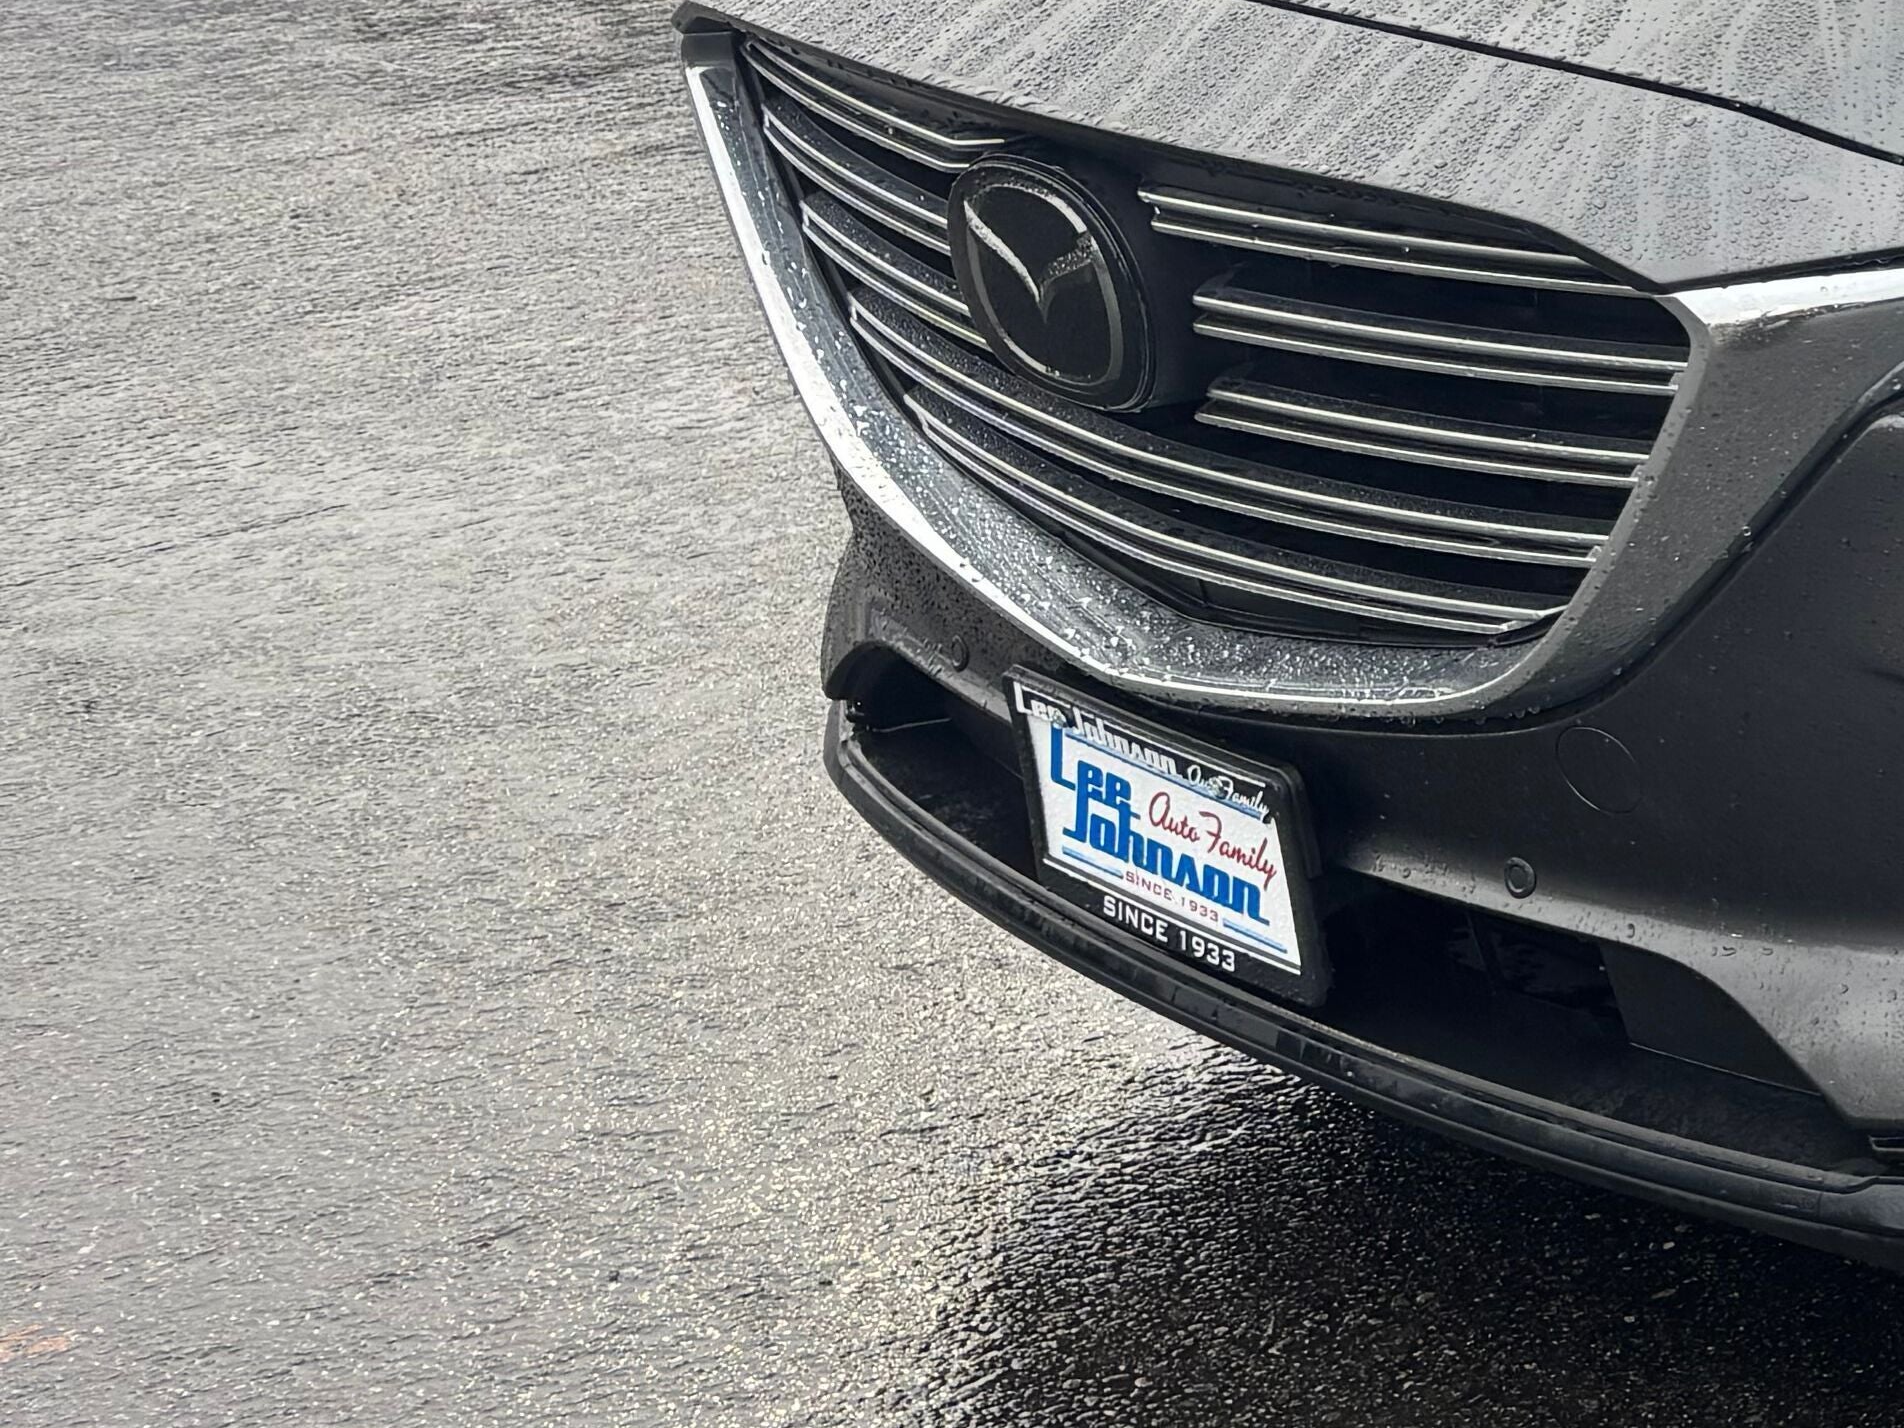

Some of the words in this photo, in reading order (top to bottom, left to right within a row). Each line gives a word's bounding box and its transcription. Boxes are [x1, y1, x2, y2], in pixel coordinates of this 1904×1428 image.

[1050, 725, 1141, 822] Lee
[1149, 792, 1200, 842] Auto
[1199, 811, 1277, 891] Family
[1070, 706, 1184, 778] Johnson
[1217, 775, 1269, 824] Family
[1062, 772, 1271, 926] Johnson
[1125, 871, 1173, 901] SINCE
[1180, 897, 1219, 922] 1933
[1103, 895, 1169, 943] SINCE
[1180, 930, 1236, 972] 1933
